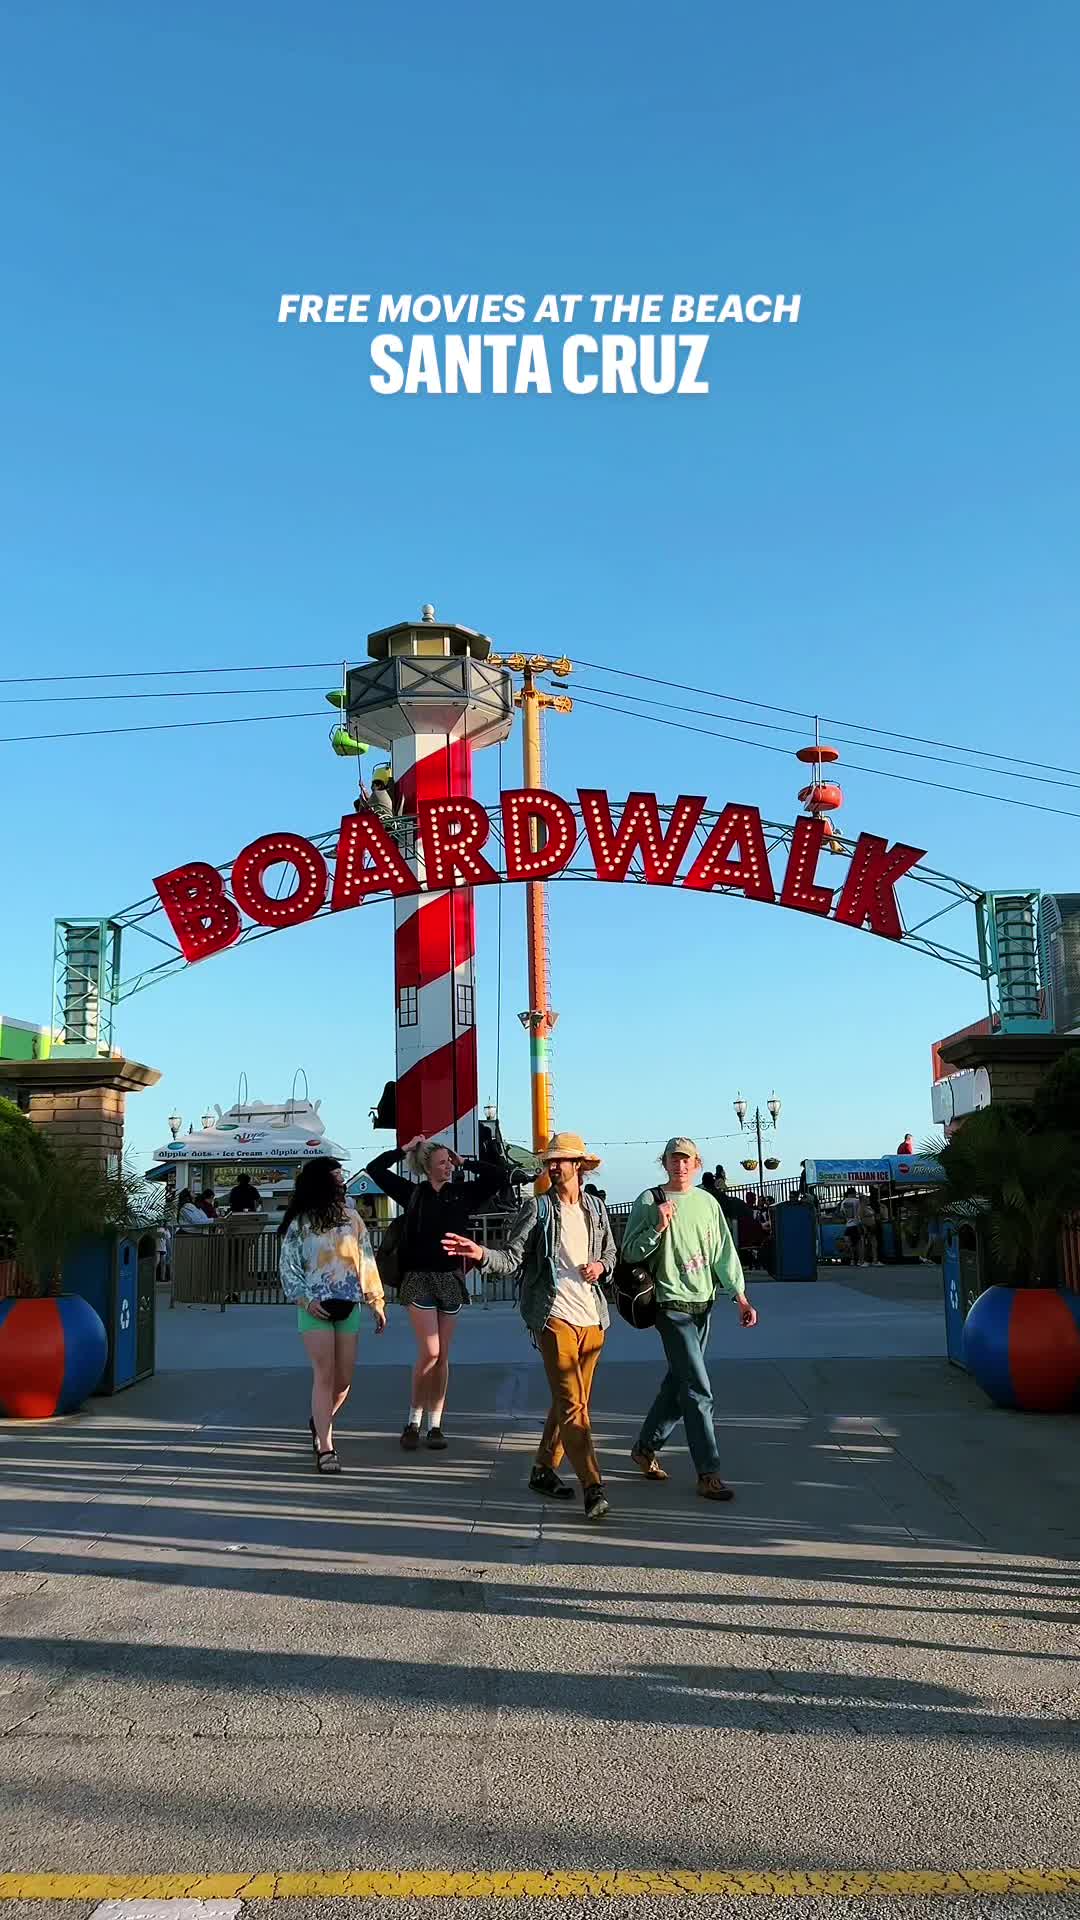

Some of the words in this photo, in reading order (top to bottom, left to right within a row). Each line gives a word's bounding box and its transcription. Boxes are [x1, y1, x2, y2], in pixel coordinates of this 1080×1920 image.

[153, 788, 927, 963] BOARDWALK
[847, 1171, 876, 1181] ITALIAN
[877, 1171, 890, 1181] ICE
